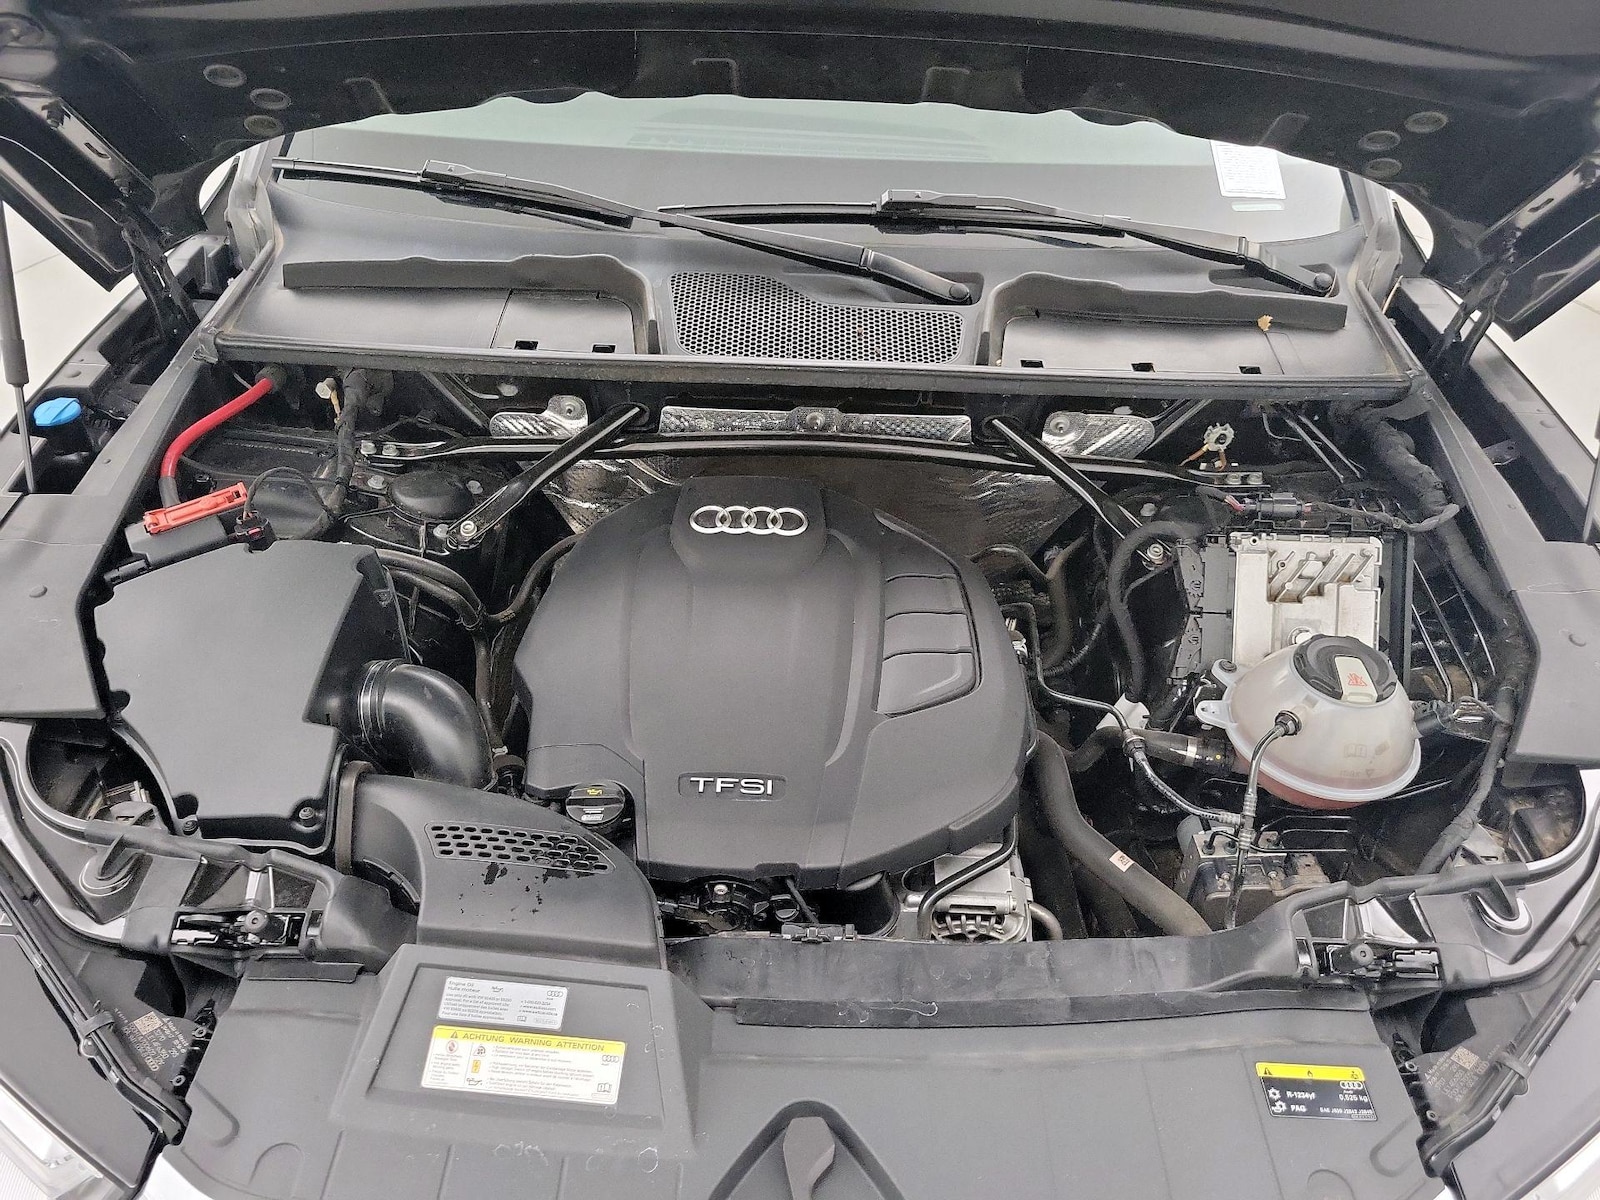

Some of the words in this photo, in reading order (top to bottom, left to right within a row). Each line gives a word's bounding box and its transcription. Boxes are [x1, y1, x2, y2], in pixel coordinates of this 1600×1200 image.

[690, 776, 774, 796] TFSI
[462, 1032, 504, 1043] ACHTUNG
[509, 1036, 552, 1047] WARNING
[556, 1041, 605, 1051] ATTENTION
[1358, 1094, 1369, 1103] kg
[1290, 1104, 1307, 1113] PAG
